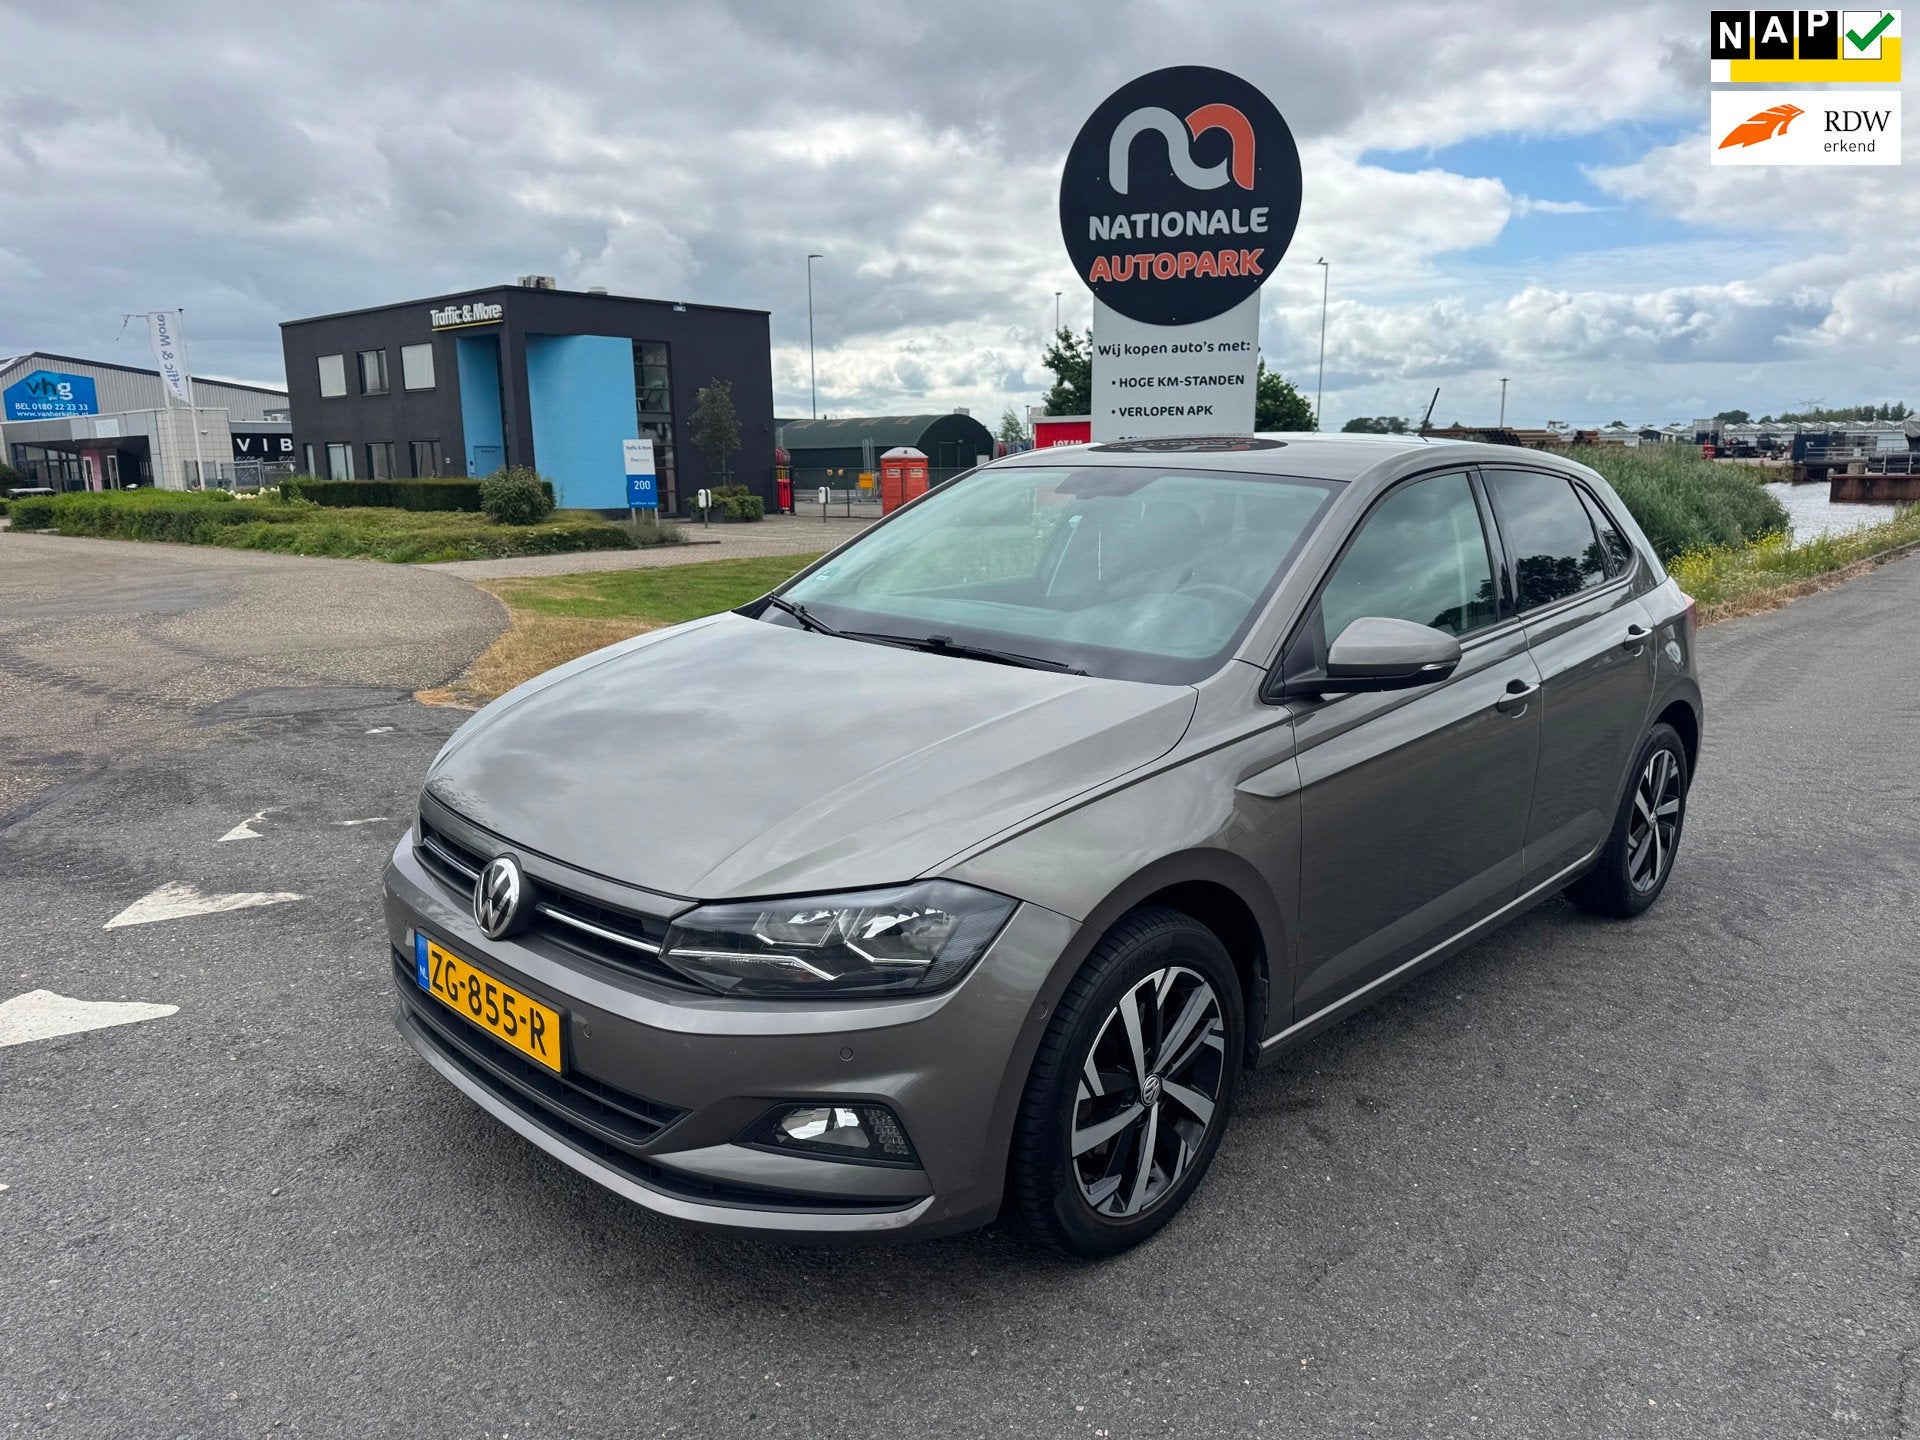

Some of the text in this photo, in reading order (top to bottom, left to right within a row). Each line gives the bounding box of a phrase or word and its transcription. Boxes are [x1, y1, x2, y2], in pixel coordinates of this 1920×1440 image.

[1088, 206, 1270, 241] NATIONALE
[1089, 248, 1265, 283] AUTOPARK
[430, 302, 503, 327] Traffic & More
[1098, 340, 1251, 358] Wij kopen auto's met:
[26, 377, 74, 401] vhg
[1119, 375, 1245, 388] HOGE KM-STANDEN
[15, 402, 89, 411] BEL 0180 22 23 33
[1119, 405, 1214, 417] VERLOPEN APK
[633, 480, 651, 490] 200
[431, 949, 547, 1057] ZG-855-R
